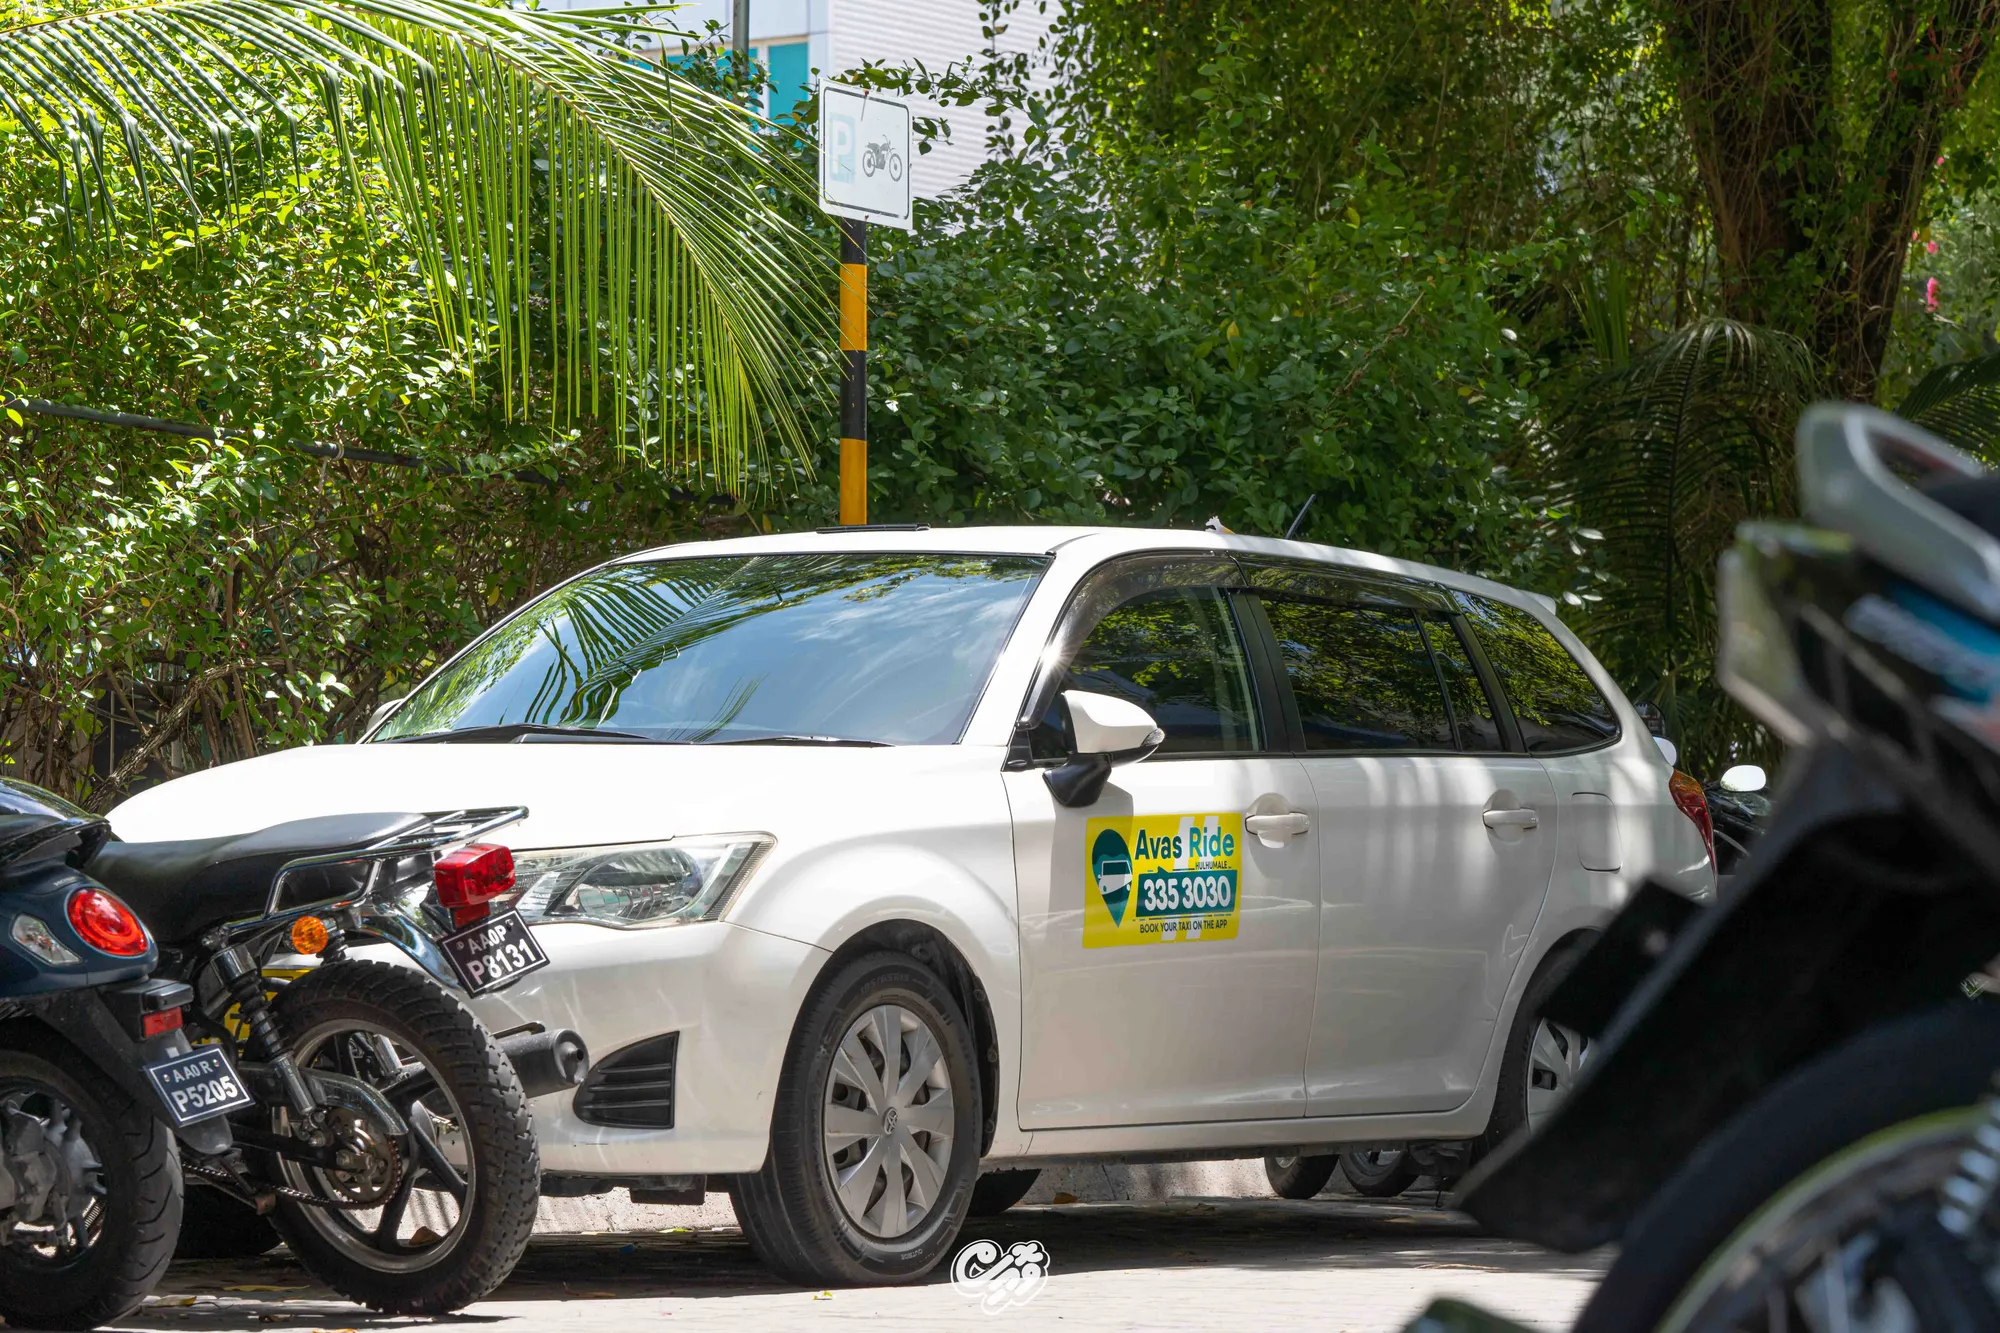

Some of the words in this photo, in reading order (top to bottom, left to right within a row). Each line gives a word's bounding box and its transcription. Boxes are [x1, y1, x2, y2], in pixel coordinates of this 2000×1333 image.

[832, 119, 853, 175] P
[1135, 829, 1182, 860] Avas
[1189, 827, 1234, 858] Ride
[1195, 861, 1228, 870] HULHUMALE
[1144, 878, 1179, 911] 335
[1182, 875, 1231, 909] 3030
[1140, 923, 1159, 933] BOOK
[1160, 921, 1178, 932] YOUR
[1178, 920, 1192, 931] TAXI
[1192, 920, 1202, 930] ON
[1203, 919, 1214, 930] THE
[1215, 919, 1228, 929] APP
[466, 938, 536, 986] P8131
[171, 1075, 238, 1113] P5205
